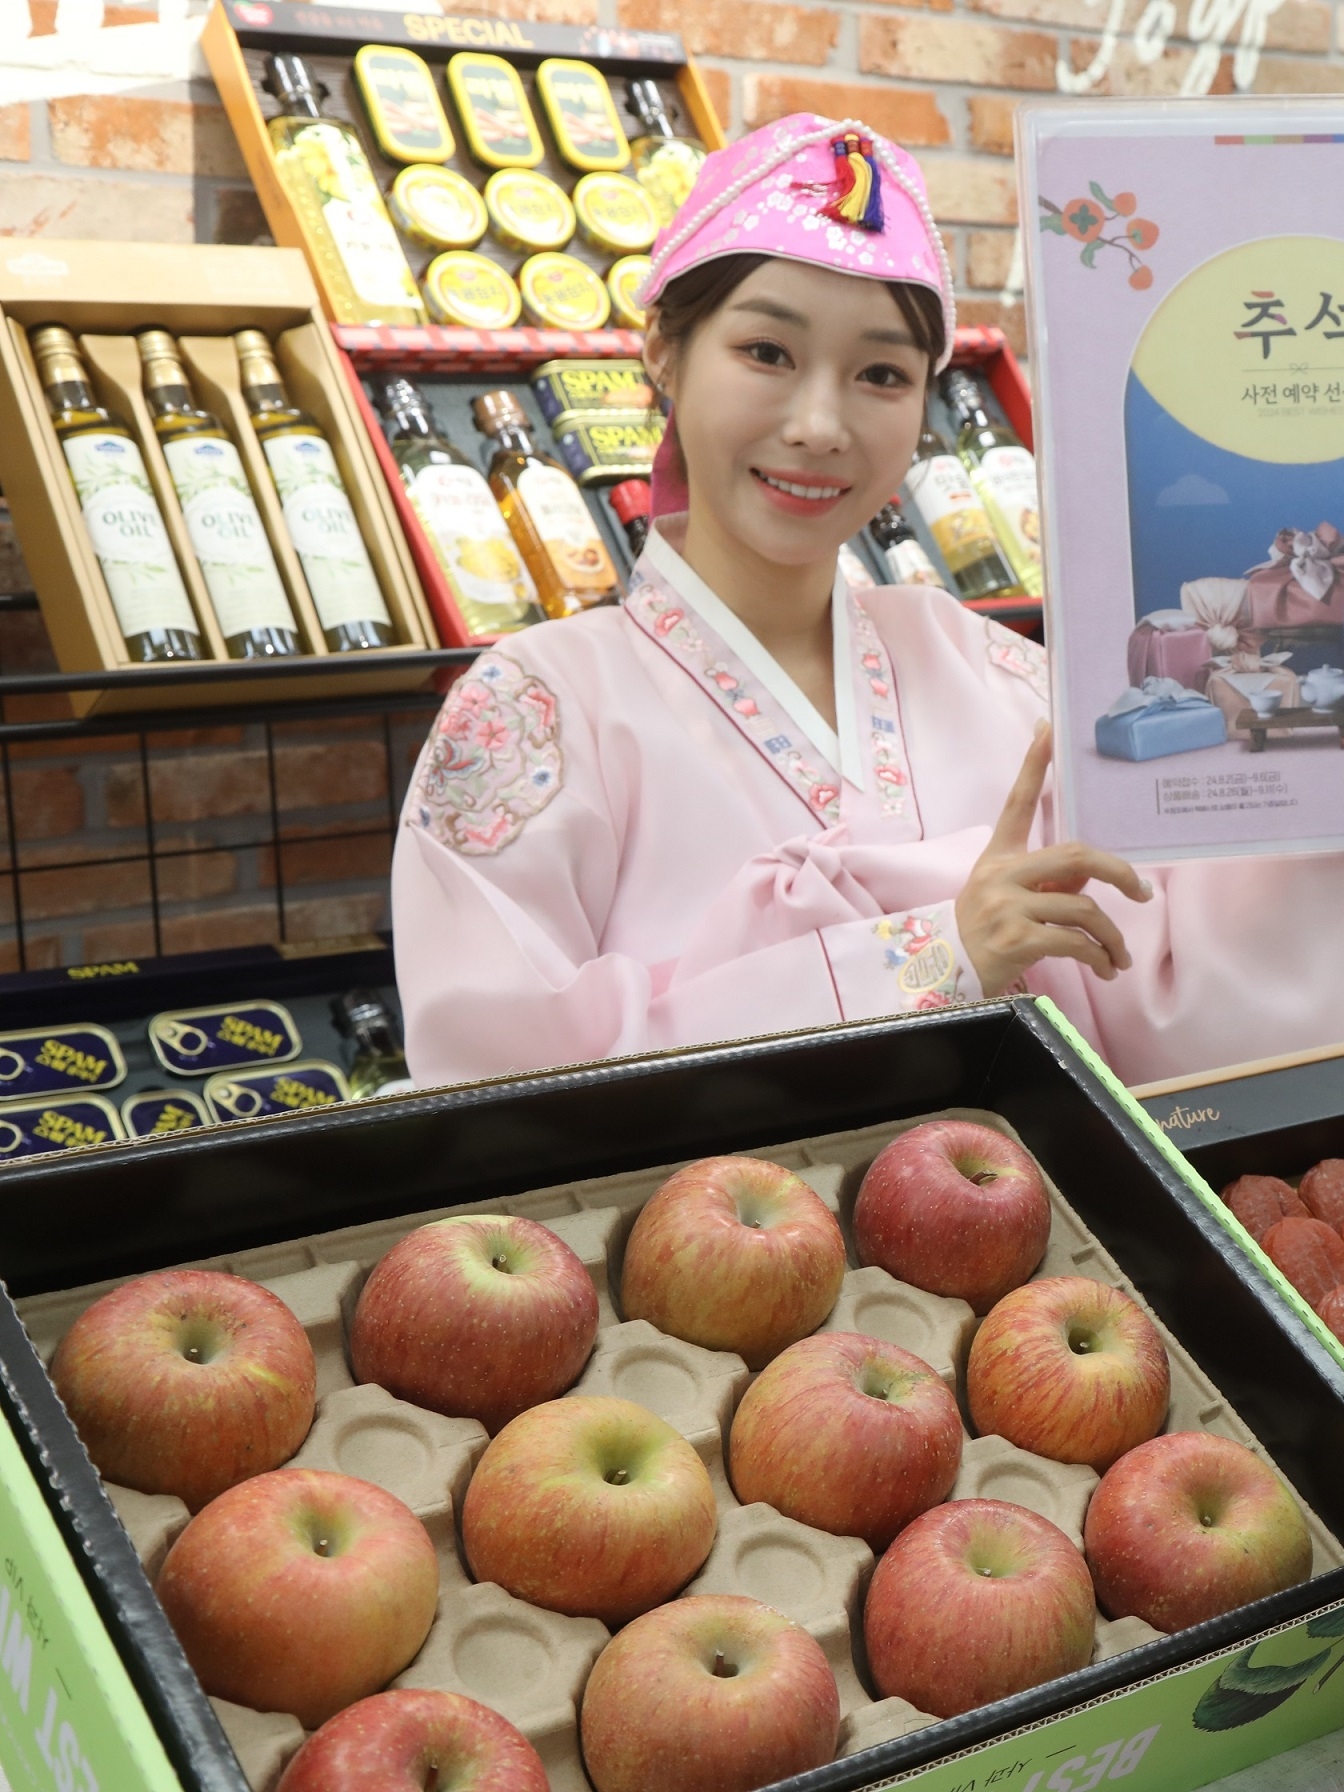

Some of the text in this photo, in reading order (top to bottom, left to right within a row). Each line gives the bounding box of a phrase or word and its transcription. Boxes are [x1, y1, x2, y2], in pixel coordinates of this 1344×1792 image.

[403, 13, 535, 49] SPECIAL
[562, 370, 638, 394] SPAM
[1241, 383, 1279, 405] 사전
[1282, 383, 1320, 404] 예약
[1282, 407, 1305, 416] BEST
[67, 960, 140, 980] SPAM
[223, 1014, 284, 1053] SPAM
[44, 1038, 109, 1078] SPAM
